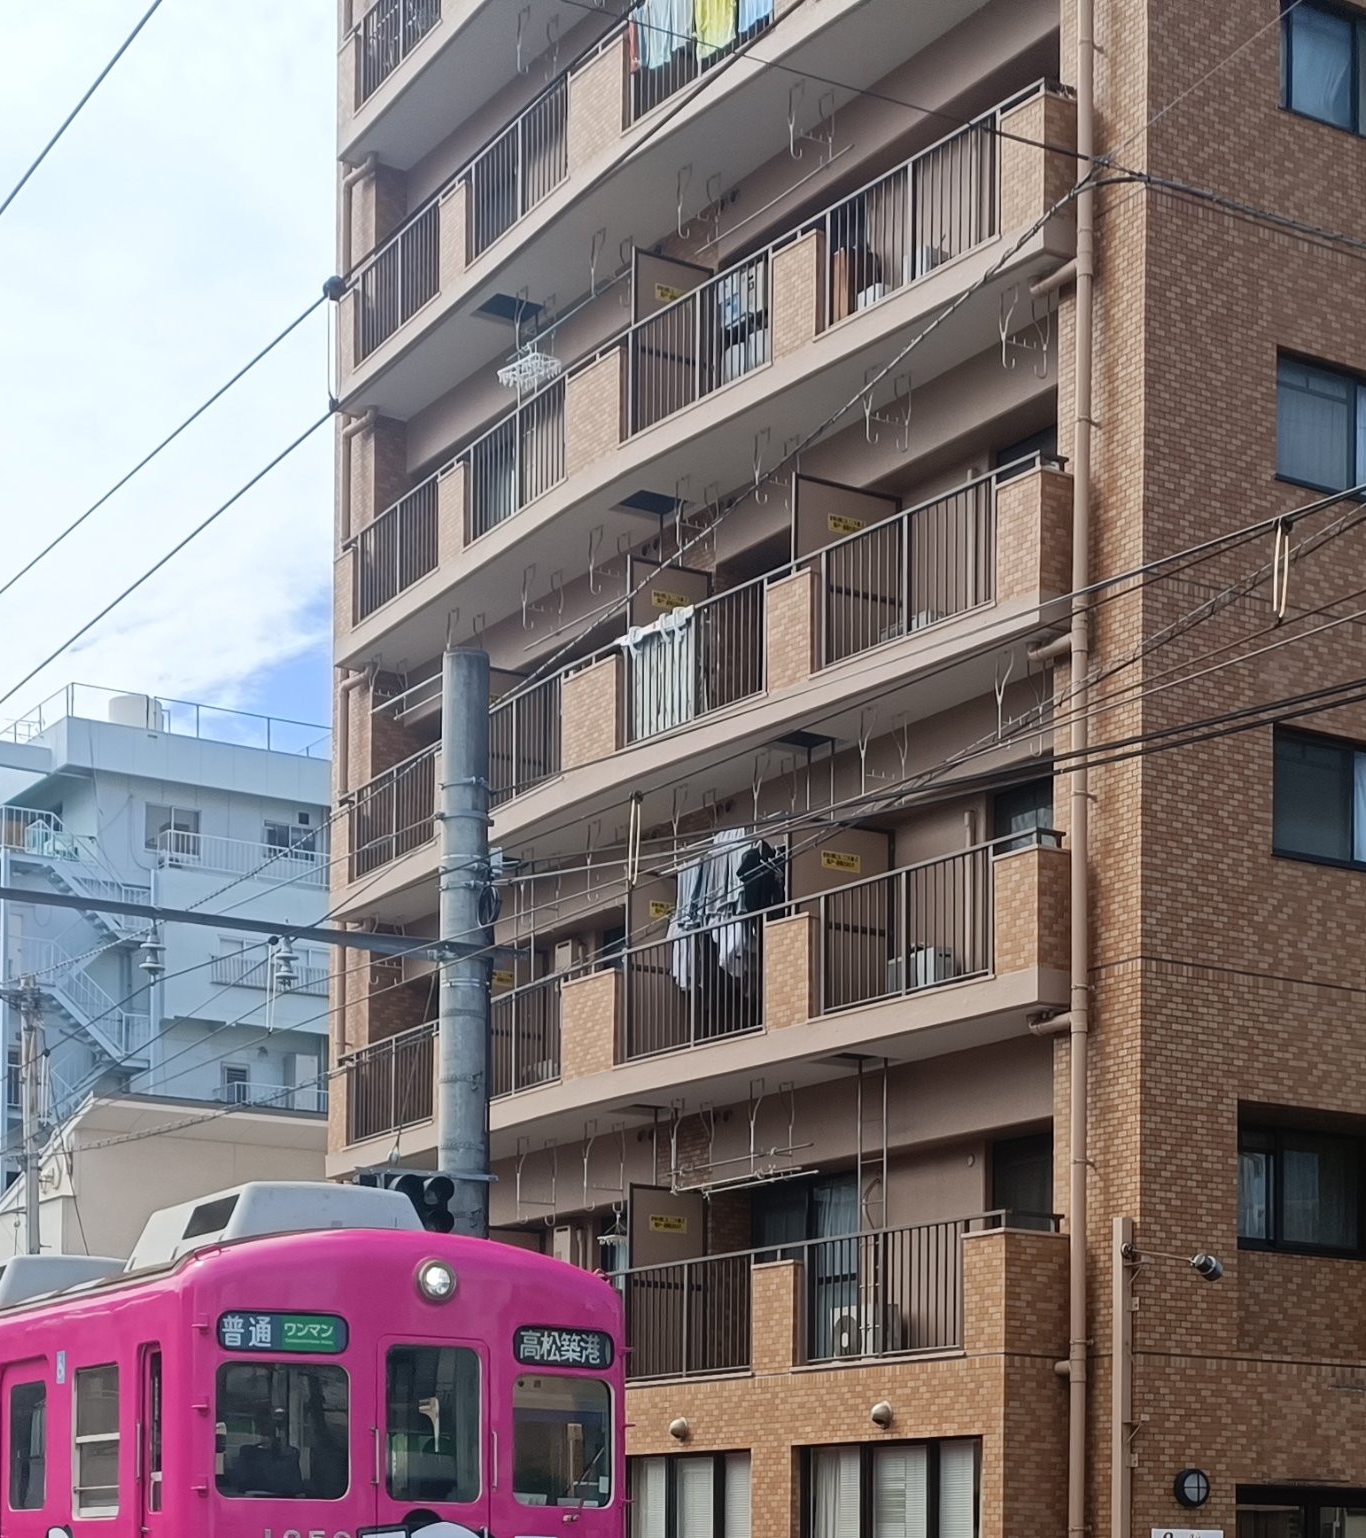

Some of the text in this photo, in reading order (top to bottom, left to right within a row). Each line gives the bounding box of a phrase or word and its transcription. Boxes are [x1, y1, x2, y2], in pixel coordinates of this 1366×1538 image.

[221, 1314, 272, 1348] 普通
[283, 1322, 334, 1338] ワンマン
[519, 1329, 601, 1364] 高松築港
